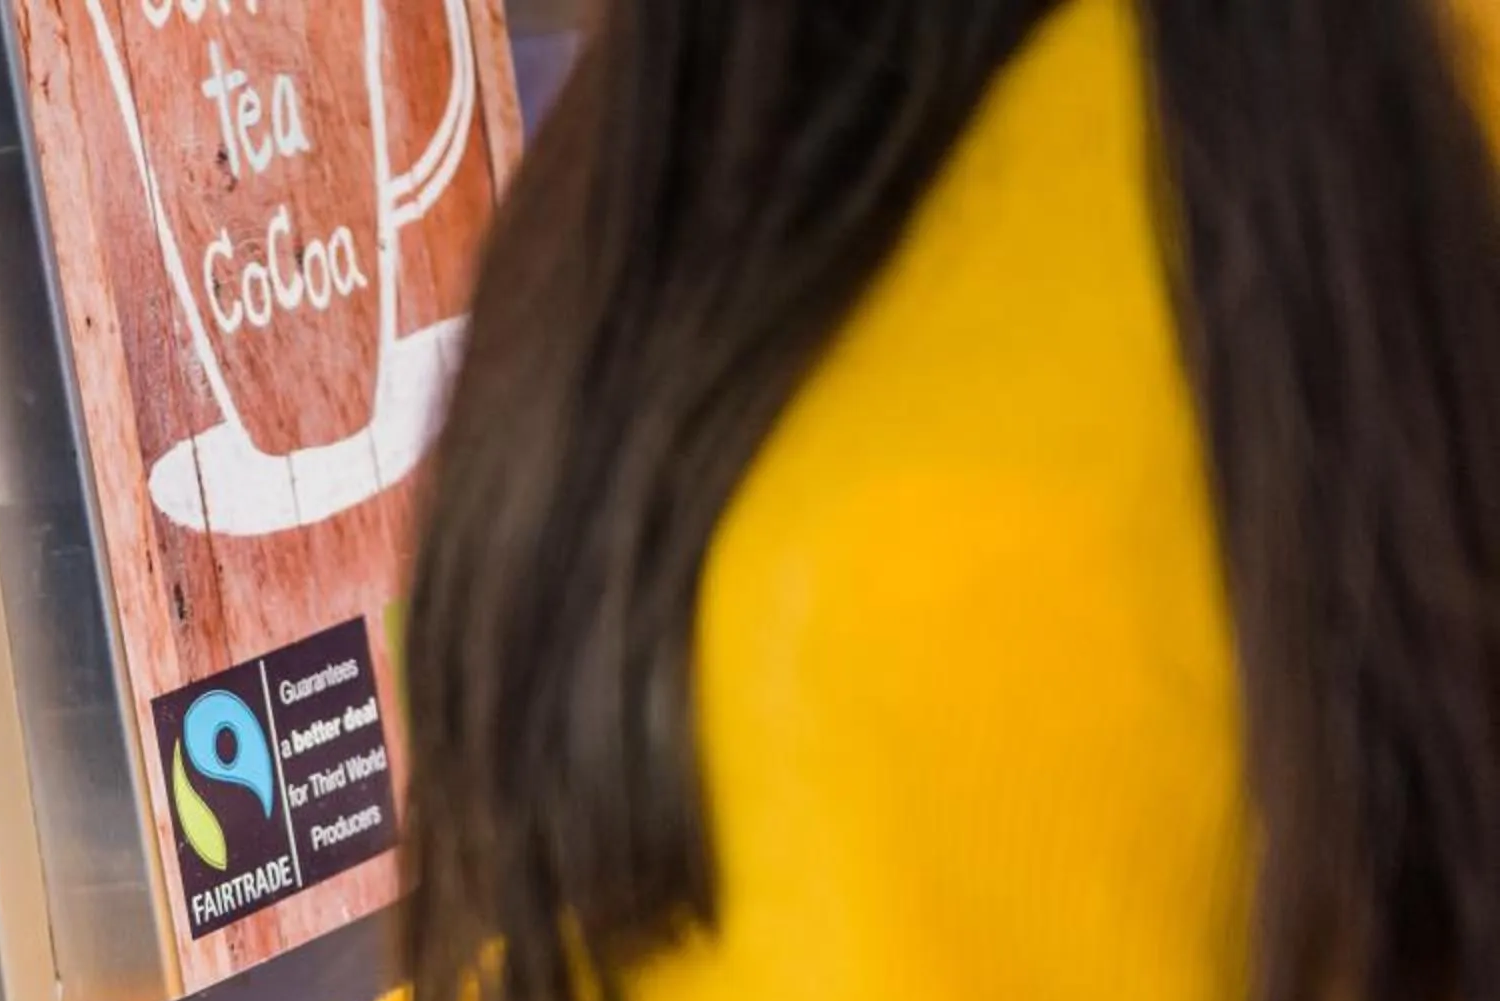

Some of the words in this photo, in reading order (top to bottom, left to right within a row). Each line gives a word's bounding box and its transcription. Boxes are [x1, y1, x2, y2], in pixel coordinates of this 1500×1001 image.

[203, 41, 310, 177] tea
[279, 658, 359, 705] Guarantees
[281, 739, 292, 759] a
[292, 716, 341, 754] better
[344, 697, 379, 732] deal
[288, 783, 309, 808] for
[309, 764, 346, 798] Third
[346, 745, 387, 781] World
[310, 804, 383, 851] Producers
[191, 855, 294, 925] FAIRTRADE
